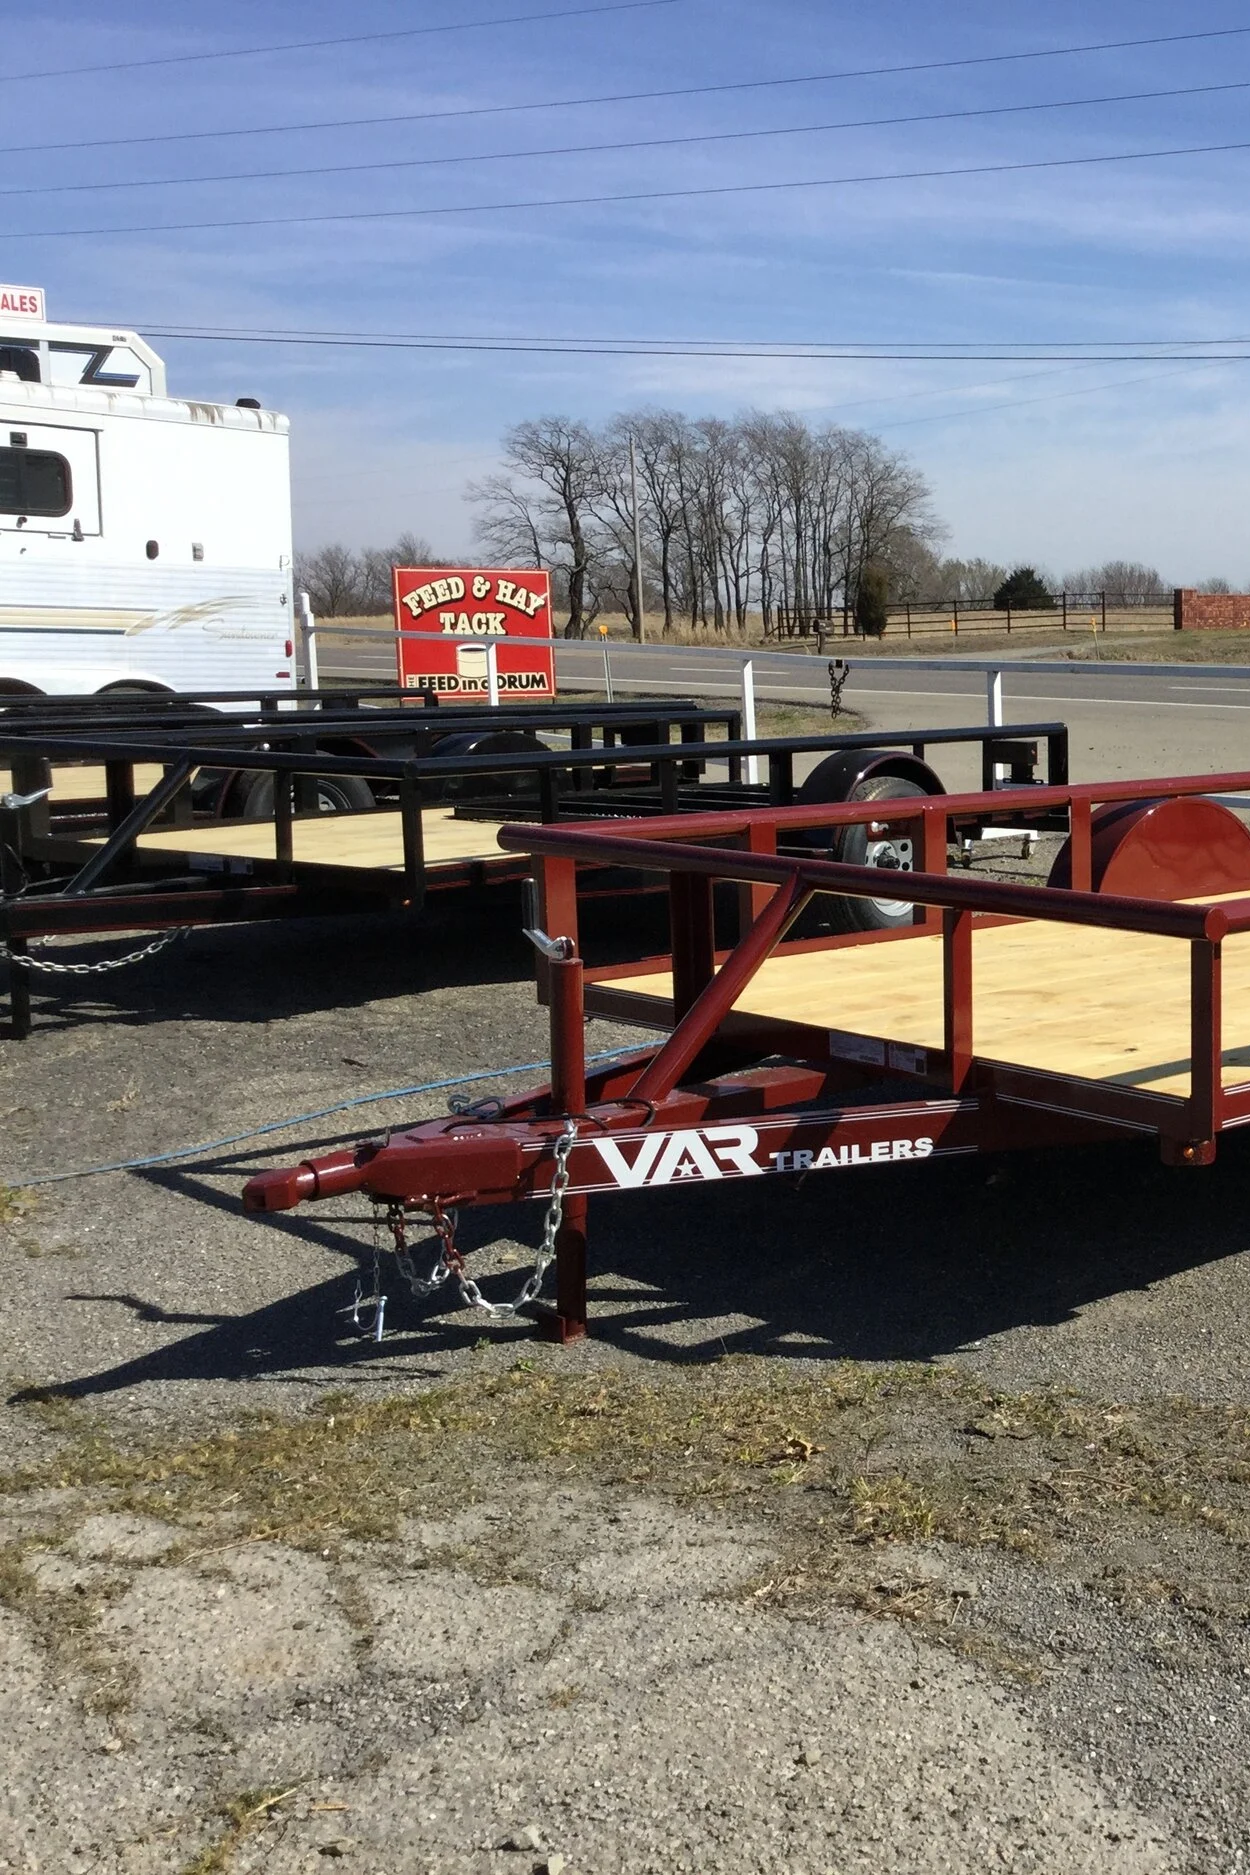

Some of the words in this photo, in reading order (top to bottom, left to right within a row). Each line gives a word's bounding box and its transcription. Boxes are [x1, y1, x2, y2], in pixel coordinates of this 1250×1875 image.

[0, 293, 38, 313] ALES
[402, 576, 465, 617] FEED
[472, 575, 491, 599] &
[495, 579, 545, 616] HAY
[440, 612, 506, 635] TACK
[418, 675, 459, 691] FEED
[497, 674, 546, 690] DRUM
[592, 1125, 766, 1188] VAR
[769, 1137, 934, 1170] TRAILERS
